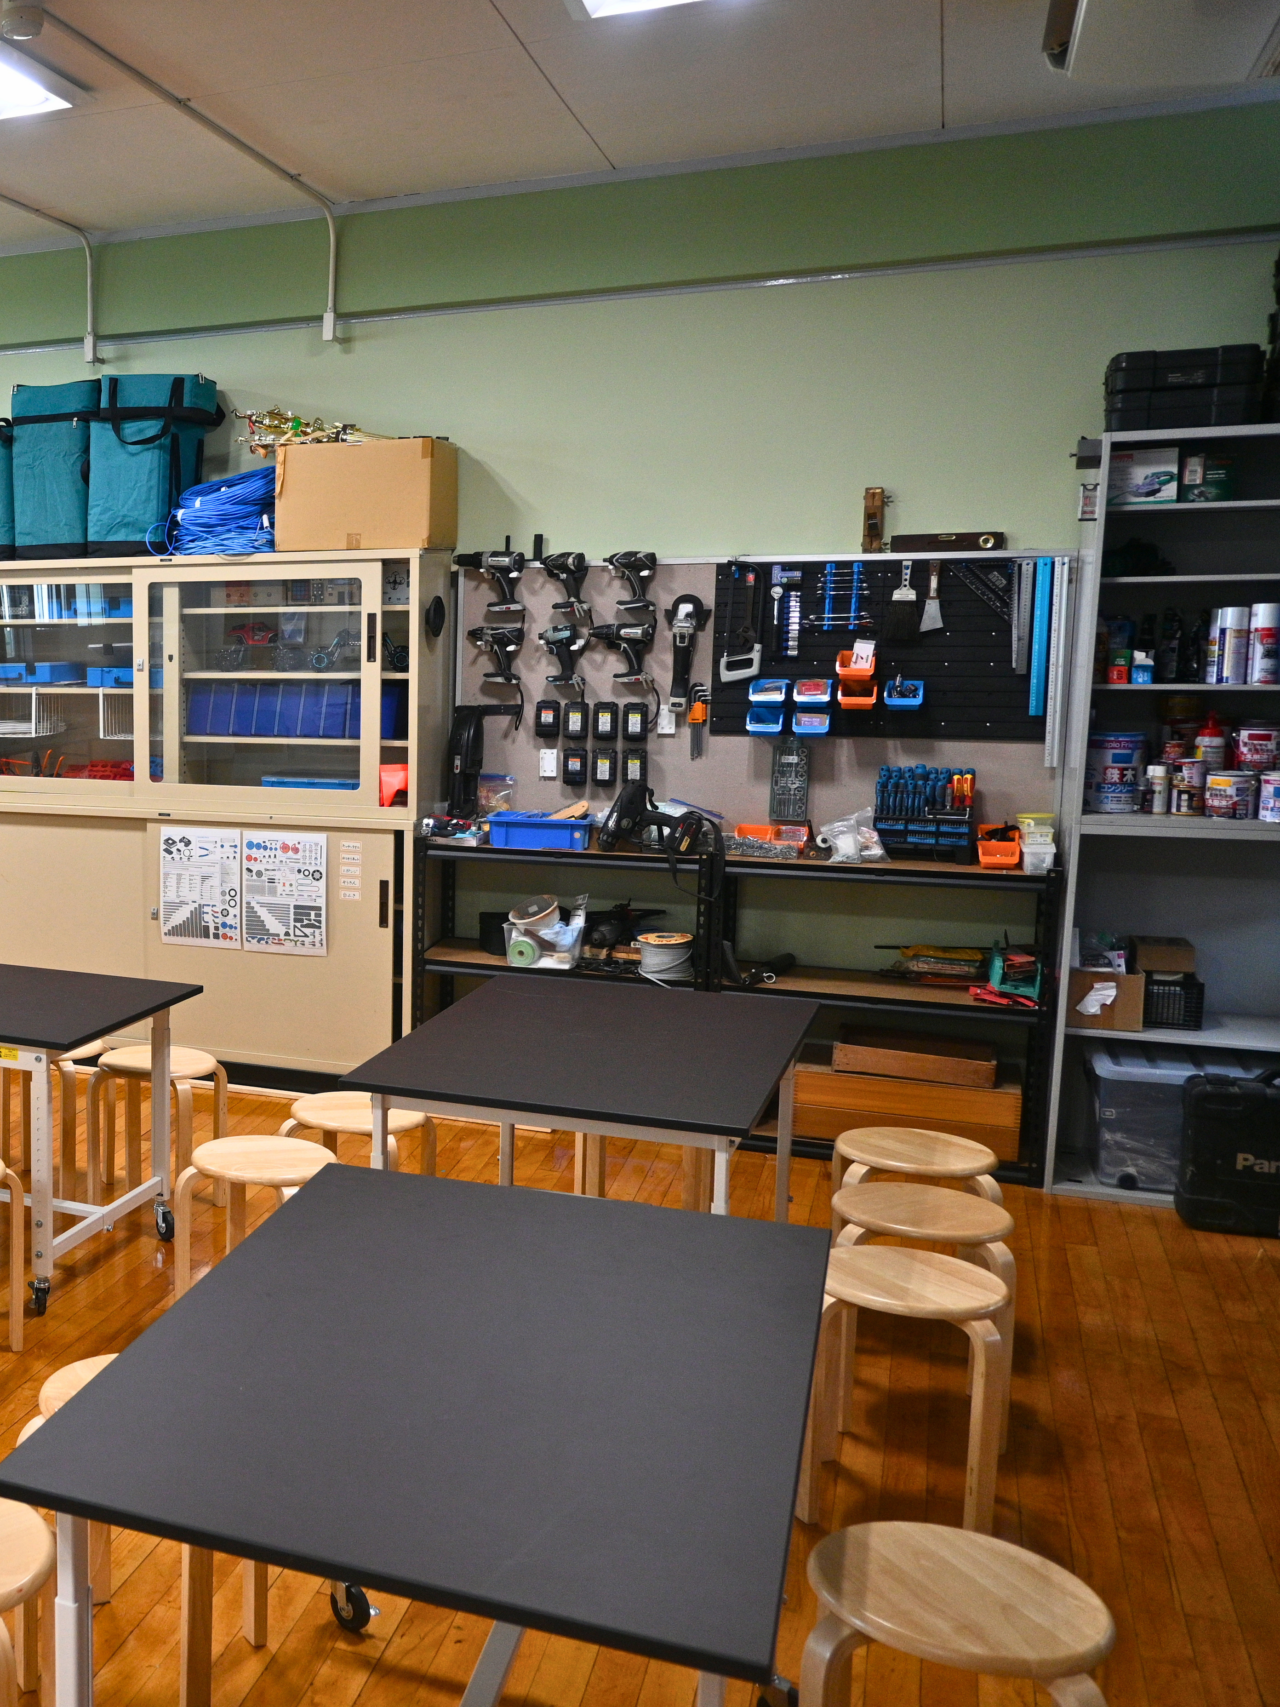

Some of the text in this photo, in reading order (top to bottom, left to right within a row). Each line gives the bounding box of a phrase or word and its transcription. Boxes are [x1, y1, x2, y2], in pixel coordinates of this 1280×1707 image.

[1100, 784, 1135, 792] コンクリー
